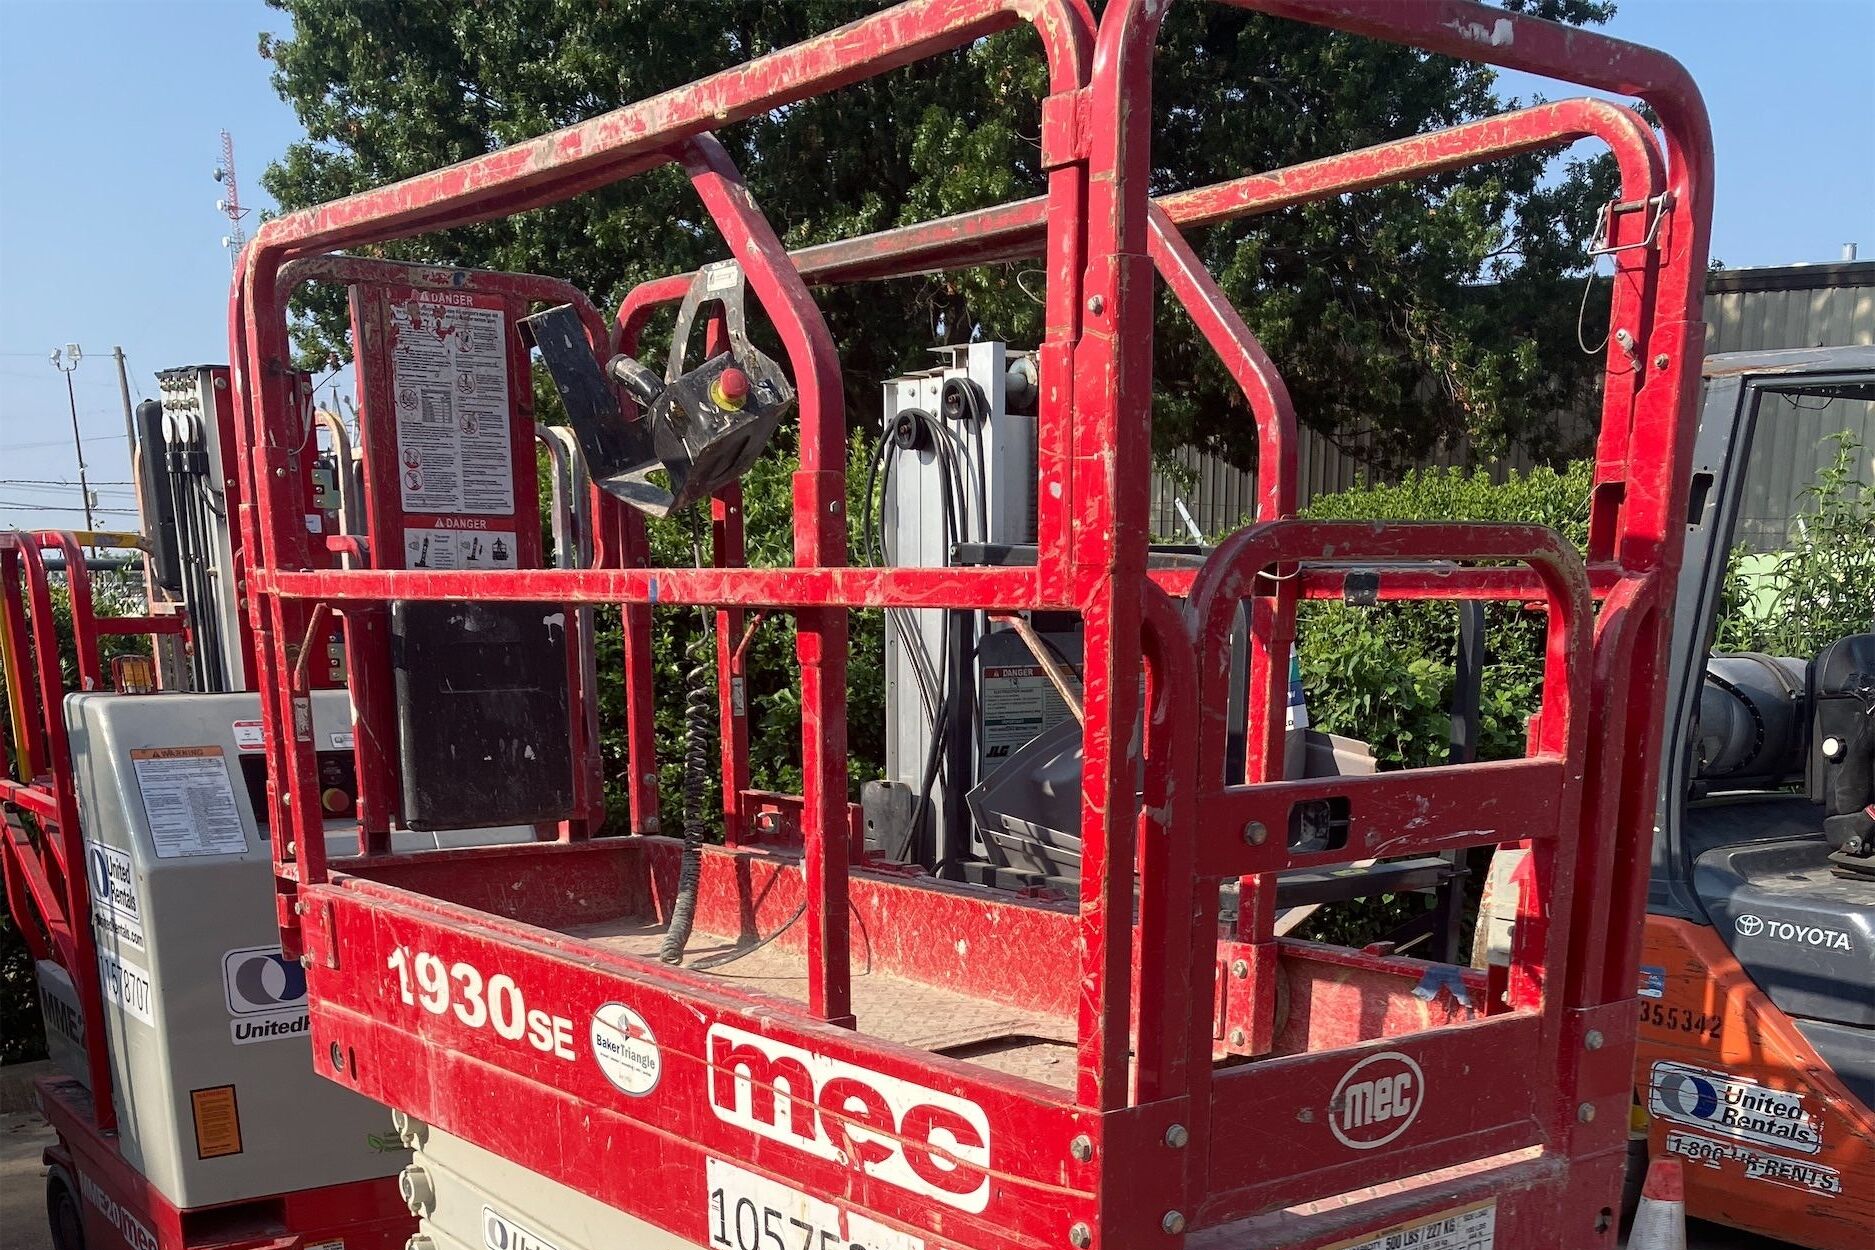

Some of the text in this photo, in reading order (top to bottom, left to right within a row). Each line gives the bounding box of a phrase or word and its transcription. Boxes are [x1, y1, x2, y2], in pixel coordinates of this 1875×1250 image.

[431, 292, 473, 307] DANGER
[446, 518, 487, 530] DANGER
[1002, 668, 1034, 677] DANGER
[985, 745, 1009, 758] JLG
[106, 854, 131, 885] United
[110, 882, 137, 912] Rentals
[1767, 920, 1850, 951] TOYOTA
[711, 1033, 986, 1196] mec
[1343, 1072, 1412, 1131] mec
[1724, 1084, 1803, 1120] United
[1721, 1106, 1811, 1142] Rentals
